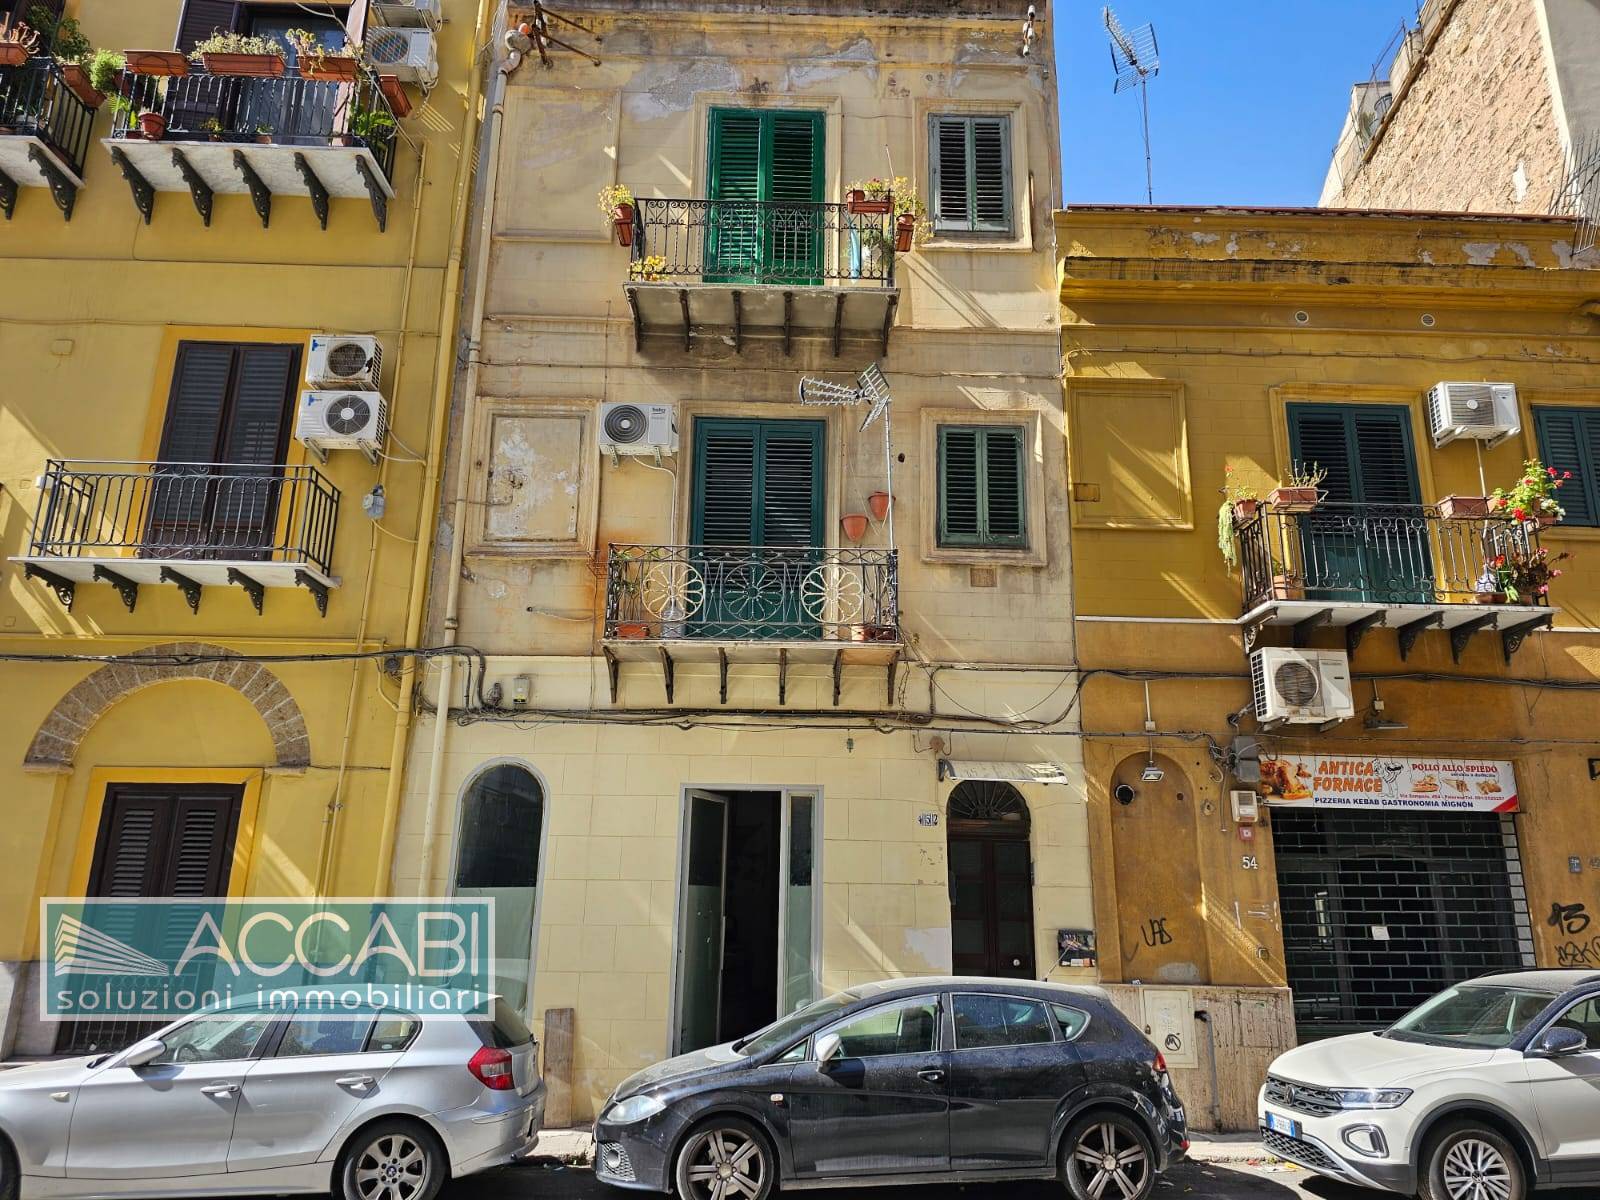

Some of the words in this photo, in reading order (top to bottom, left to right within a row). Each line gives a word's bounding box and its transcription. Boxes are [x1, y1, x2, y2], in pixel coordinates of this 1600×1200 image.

[1318, 760, 1374, 776] ANTICA
[1412, 763, 1440, 771] POLLO
[1441, 764, 1463, 772] ALLO
[1465, 765, 1498, 773] SPIEDO
[1313, 777, 1383, 792] FORNACE
[1242, 856, 1258, 870] 54
